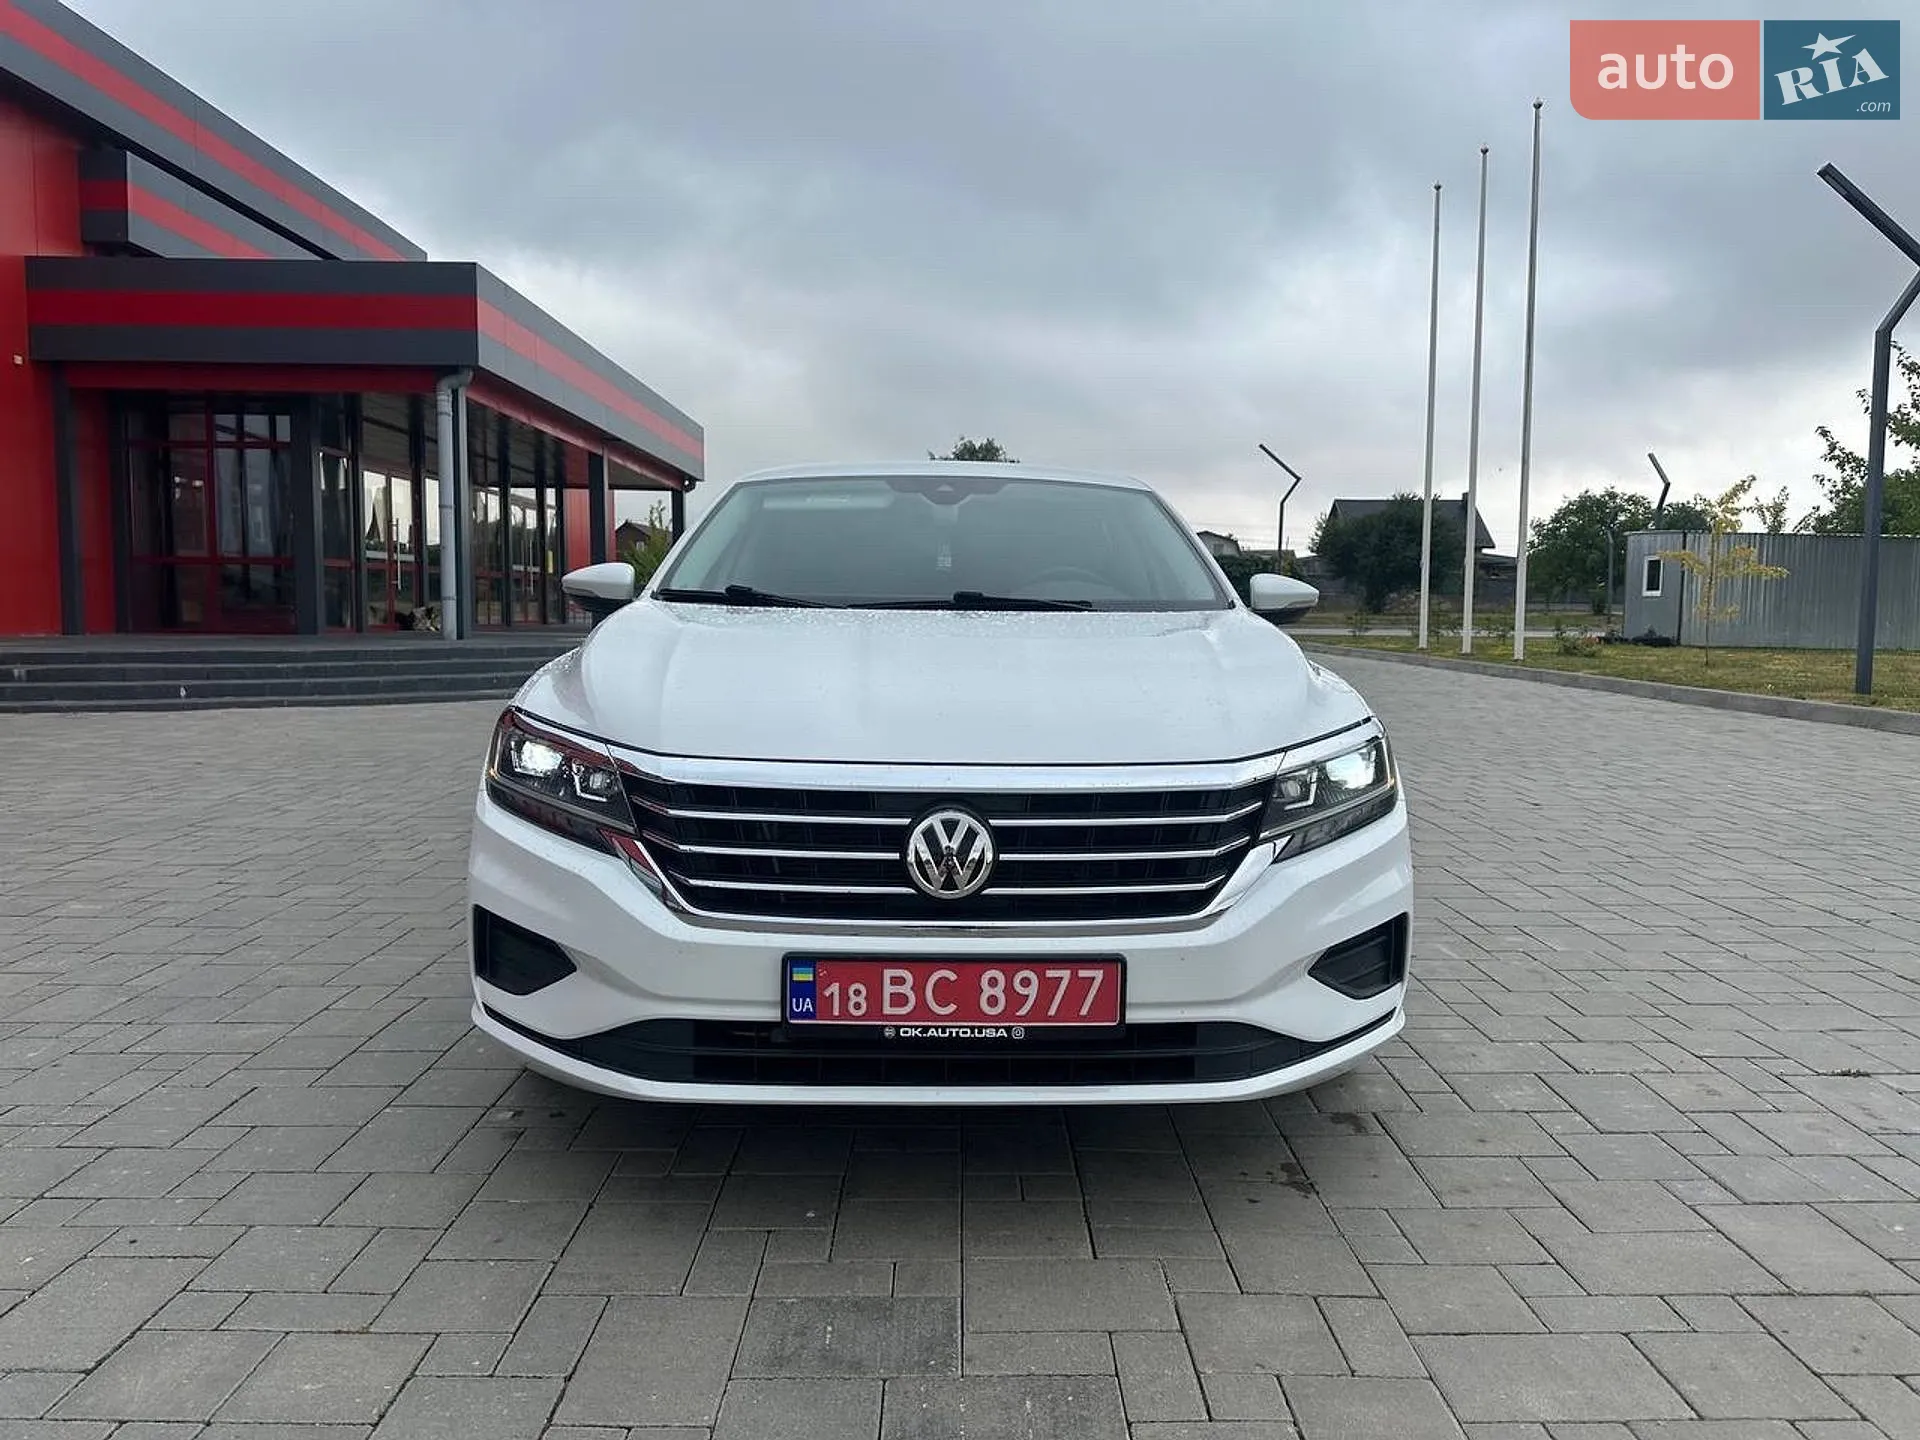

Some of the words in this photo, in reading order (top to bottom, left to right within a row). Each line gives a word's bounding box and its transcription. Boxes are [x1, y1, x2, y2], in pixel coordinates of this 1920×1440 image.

[823, 982, 867, 1016] 18
[882, 969, 958, 1015] BC
[979, 969, 1104, 1017] 8977
[792, 997, 813, 1013] UA
[899, 1026, 1008, 1038] OK.AUTO.USA
